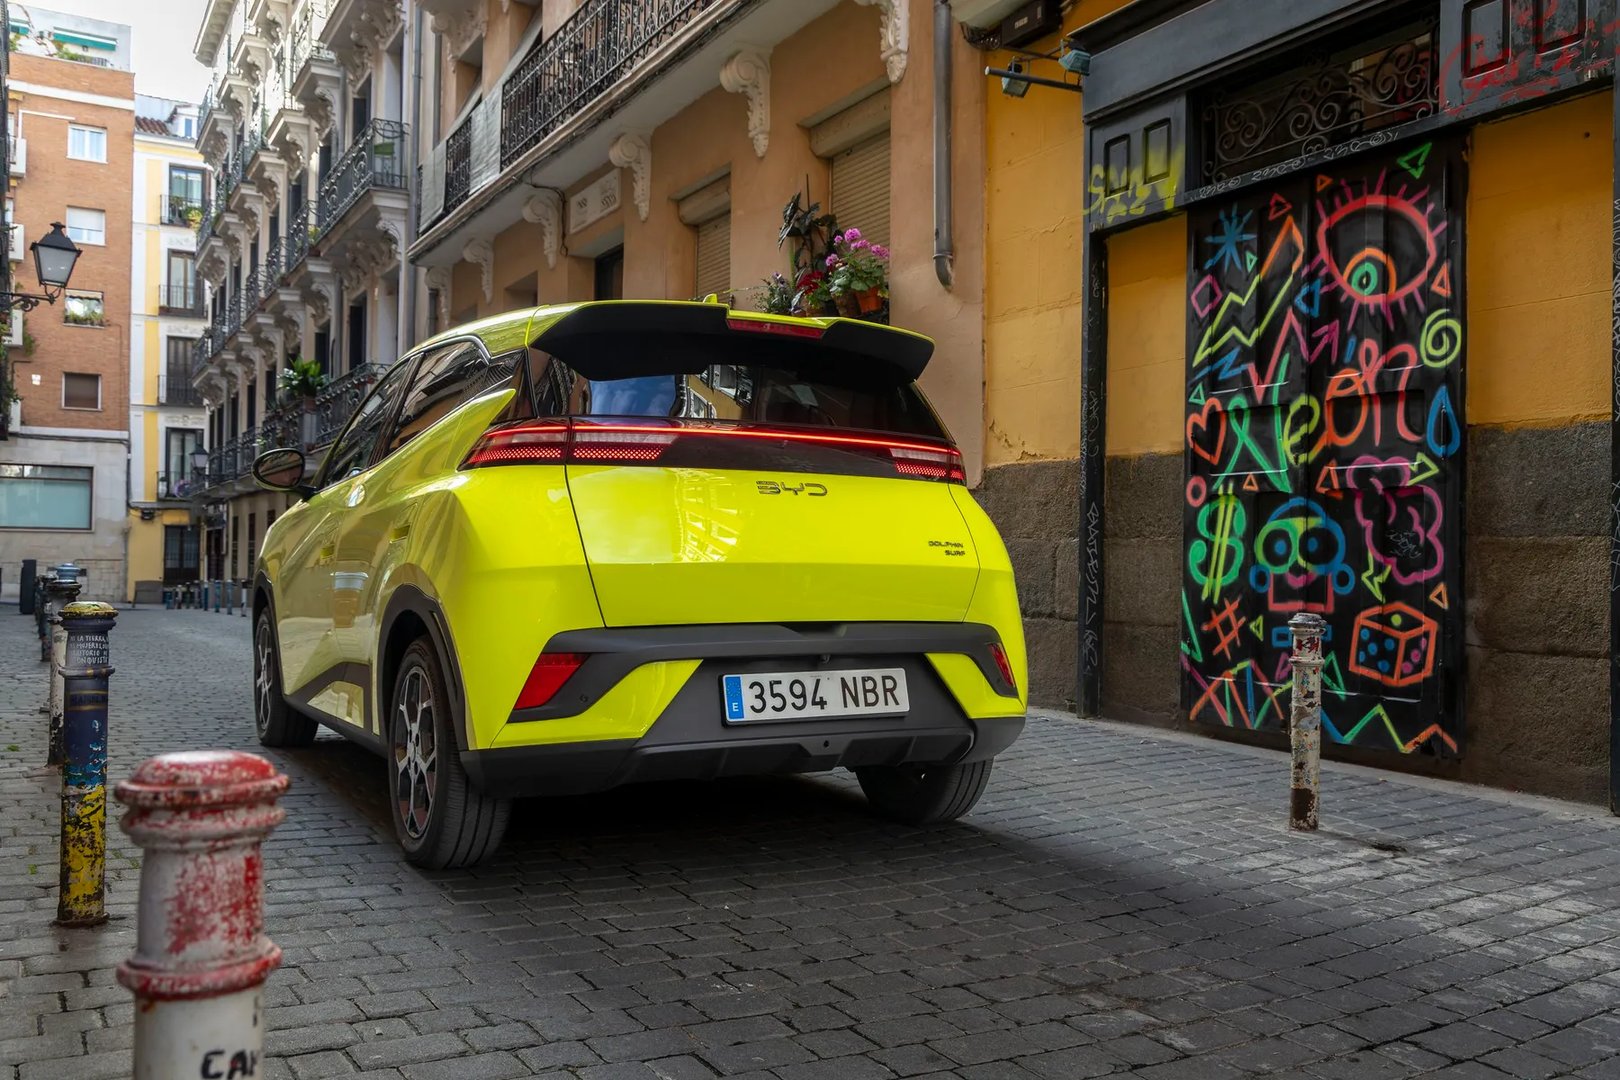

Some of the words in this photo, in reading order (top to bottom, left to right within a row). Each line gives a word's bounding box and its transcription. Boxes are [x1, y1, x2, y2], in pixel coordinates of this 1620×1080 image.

[756, 480, 828, 497] BYD
[928, 540, 963, 548] DOLPHIN
[749, 678, 828, 713] 3594
[840, 675, 900, 709] NBR
[732, 702, 739, 712] E
